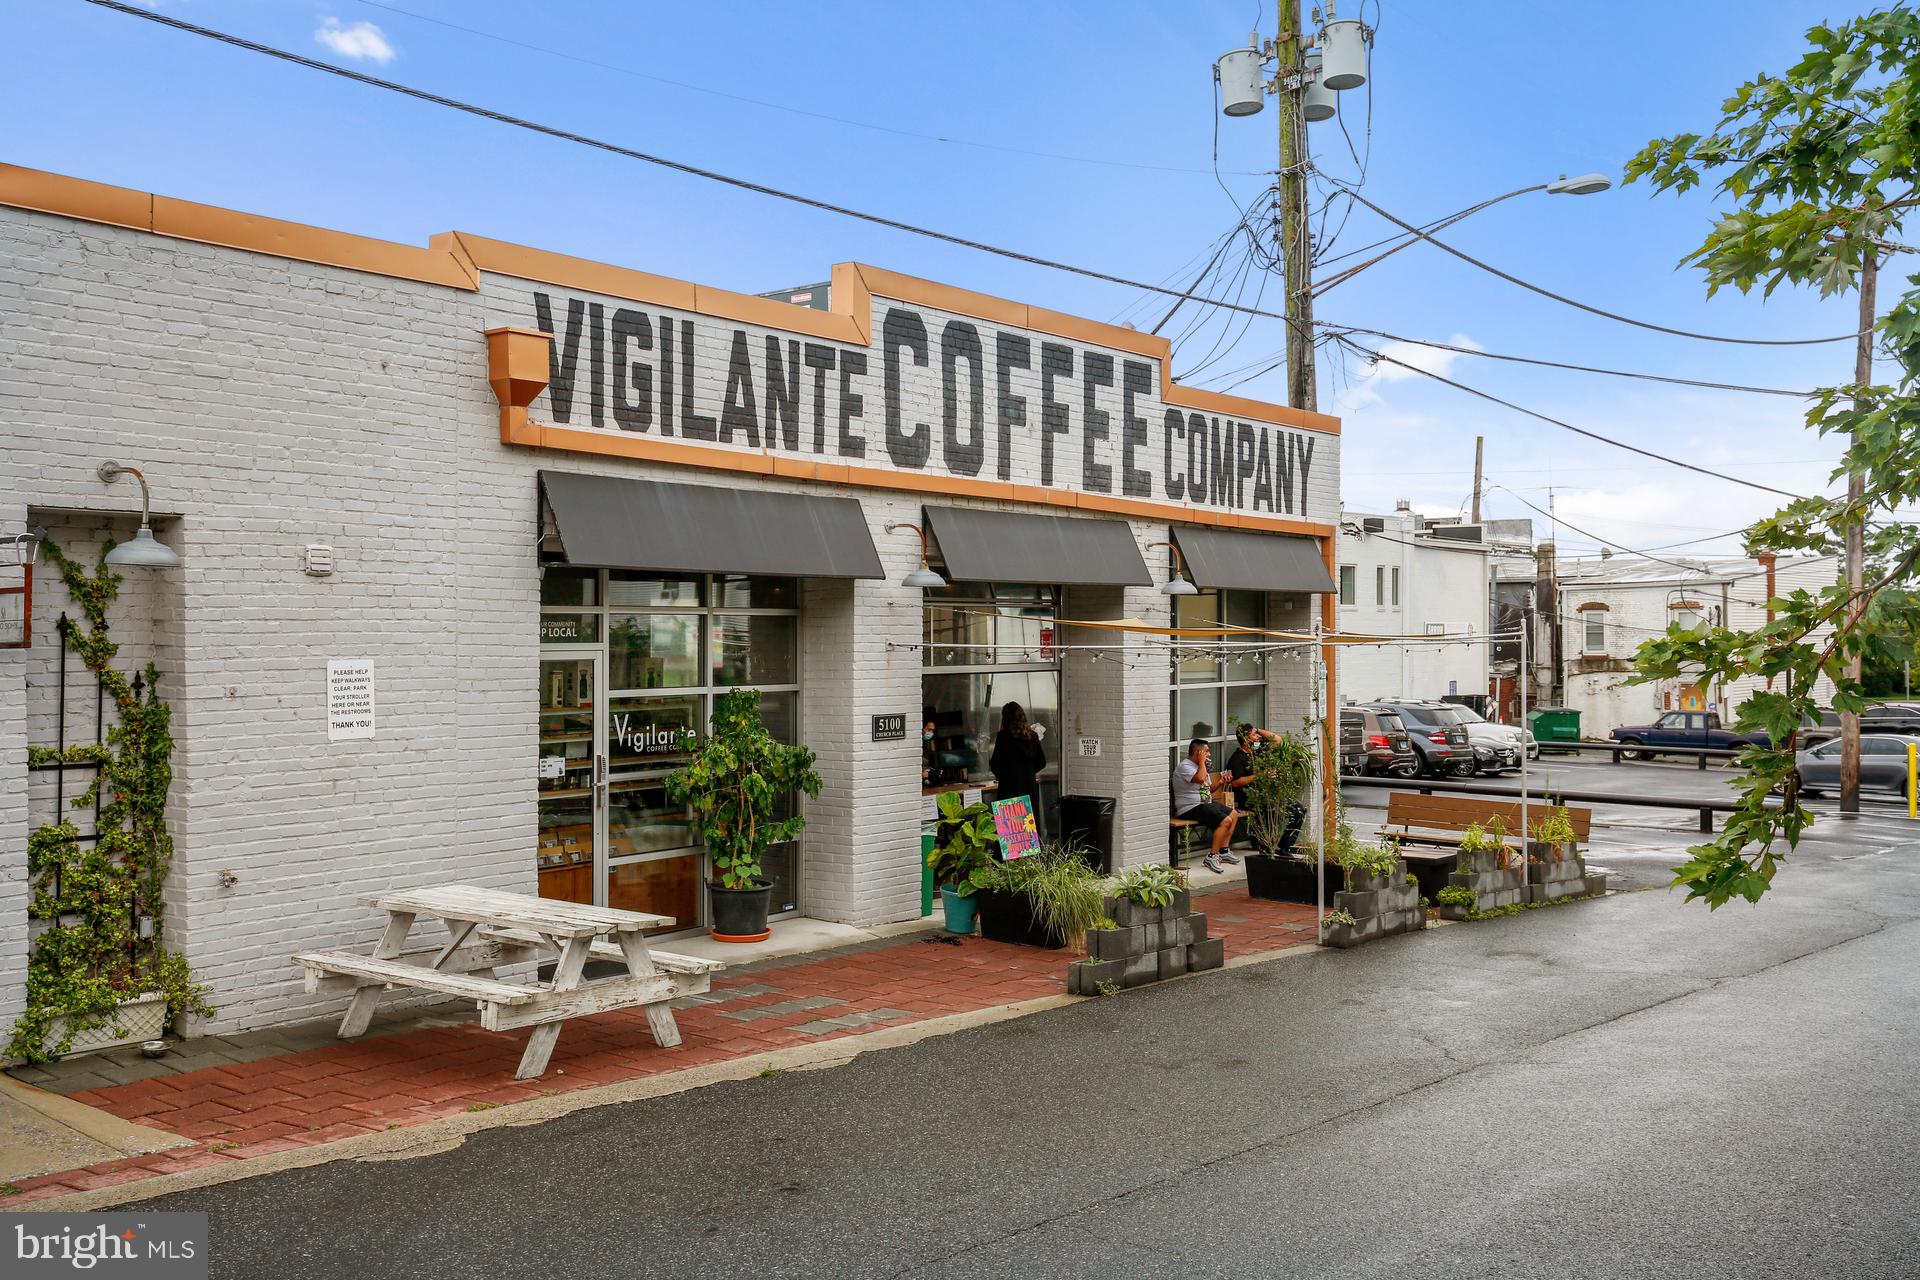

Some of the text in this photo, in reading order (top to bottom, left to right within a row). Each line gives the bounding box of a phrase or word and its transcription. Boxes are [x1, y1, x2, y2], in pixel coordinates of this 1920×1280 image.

[534, 292, 1315, 516] VIGILANTE COFFEE COMPANY
[548, 627, 577, 637] LOCAL
[879, 718, 901, 731] 5100
[998, 802, 1027, 817] THANK
[1008, 819, 1024, 832] YOU
